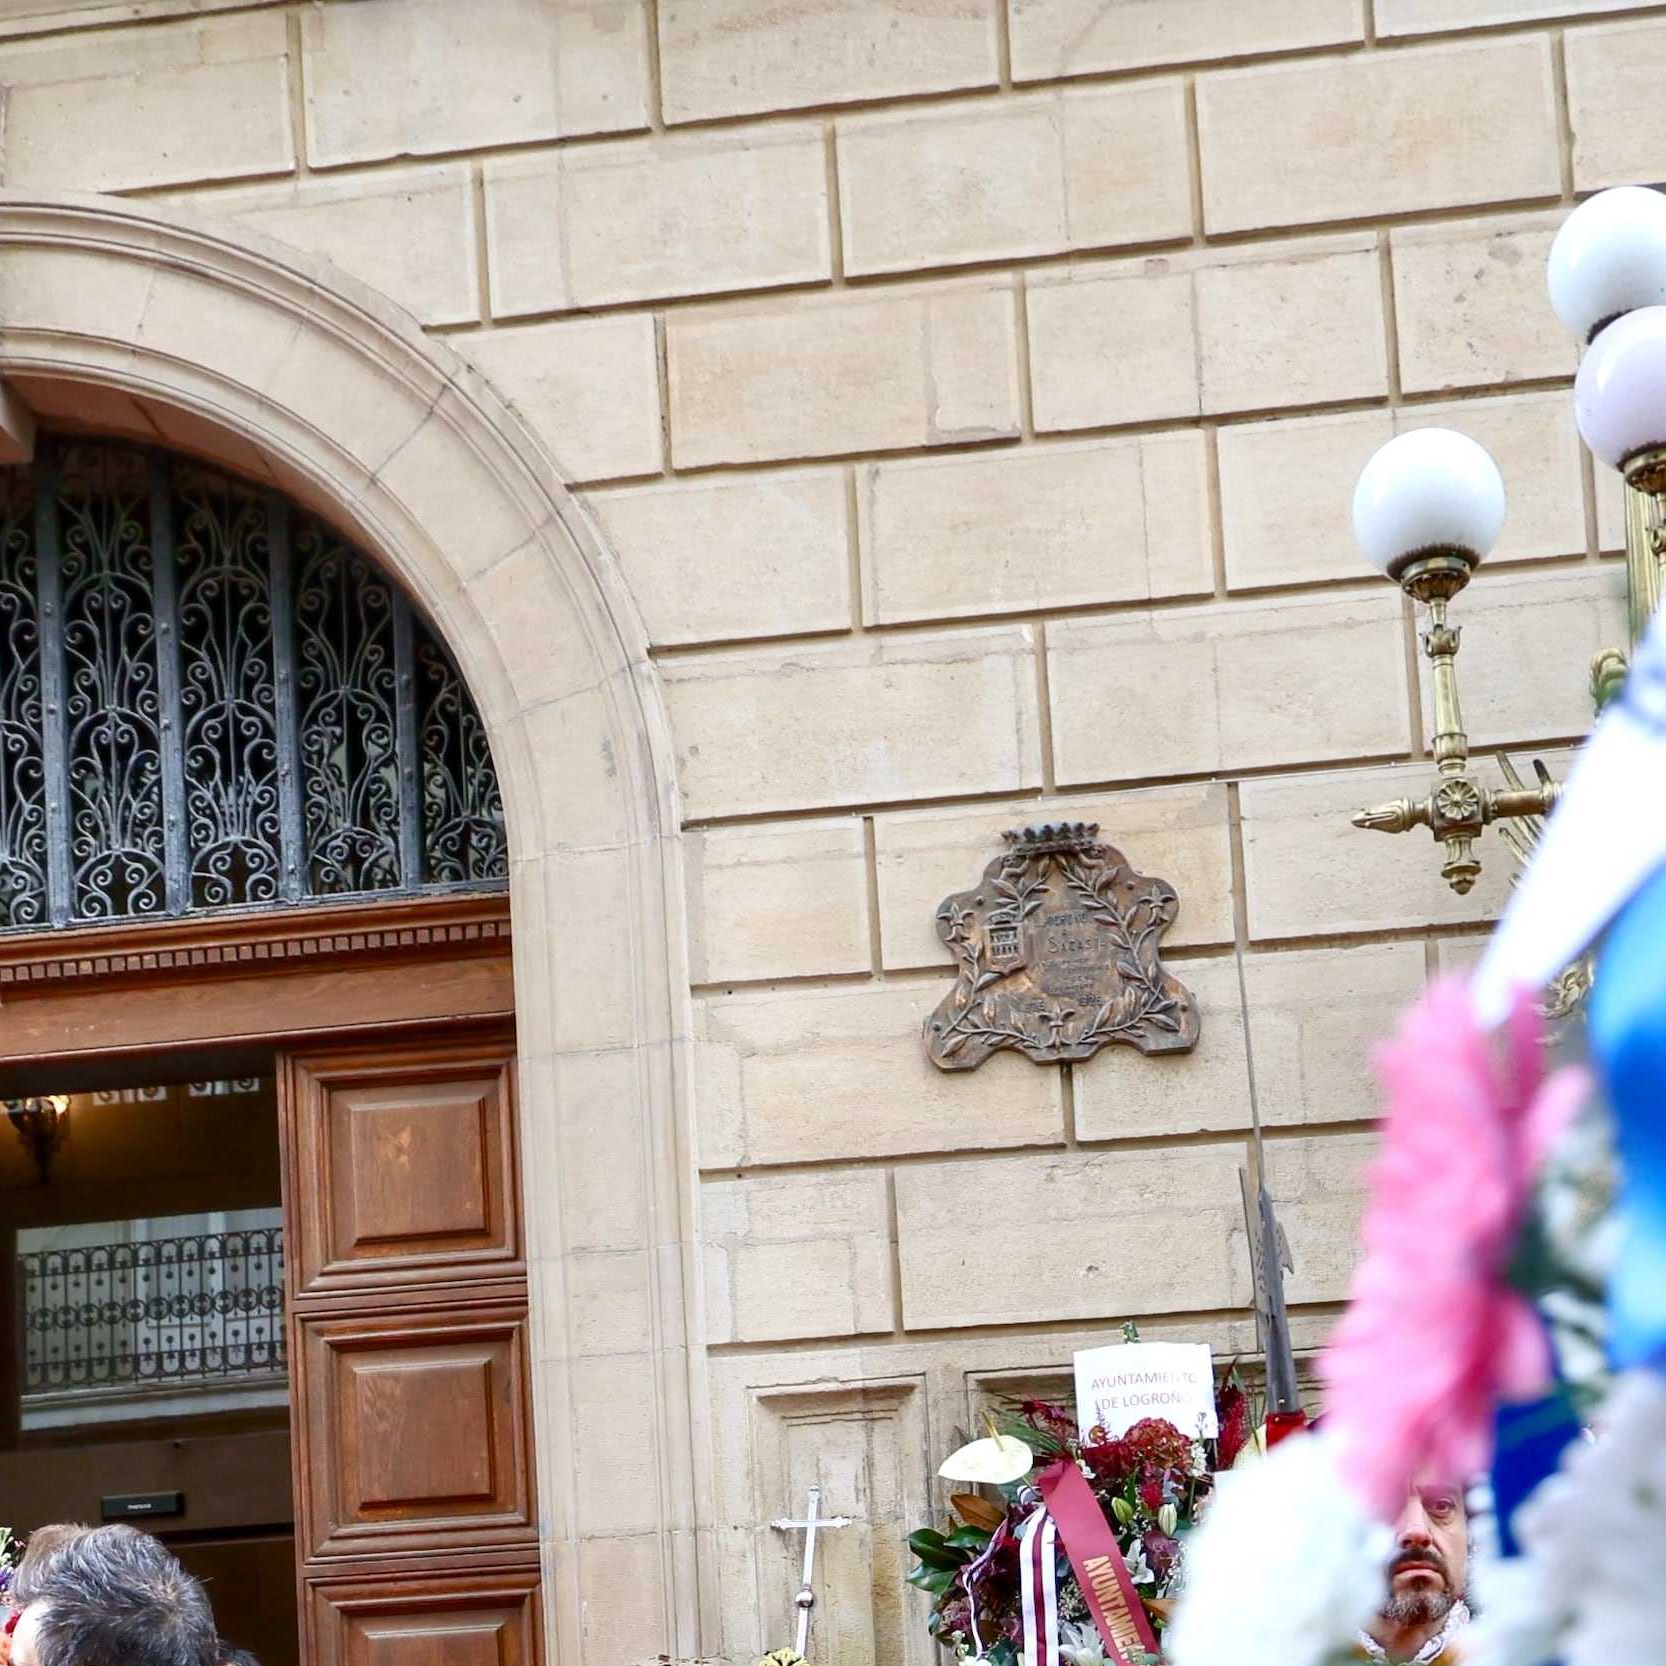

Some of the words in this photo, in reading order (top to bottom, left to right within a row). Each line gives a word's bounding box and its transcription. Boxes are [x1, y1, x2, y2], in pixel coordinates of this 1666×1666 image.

[1091, 1371, 1198, 1391] AYUNTAMIENTO
[1101, 1396, 1119, 1411] DE
[1122, 1389, 1193, 1408] LOGROÑO
